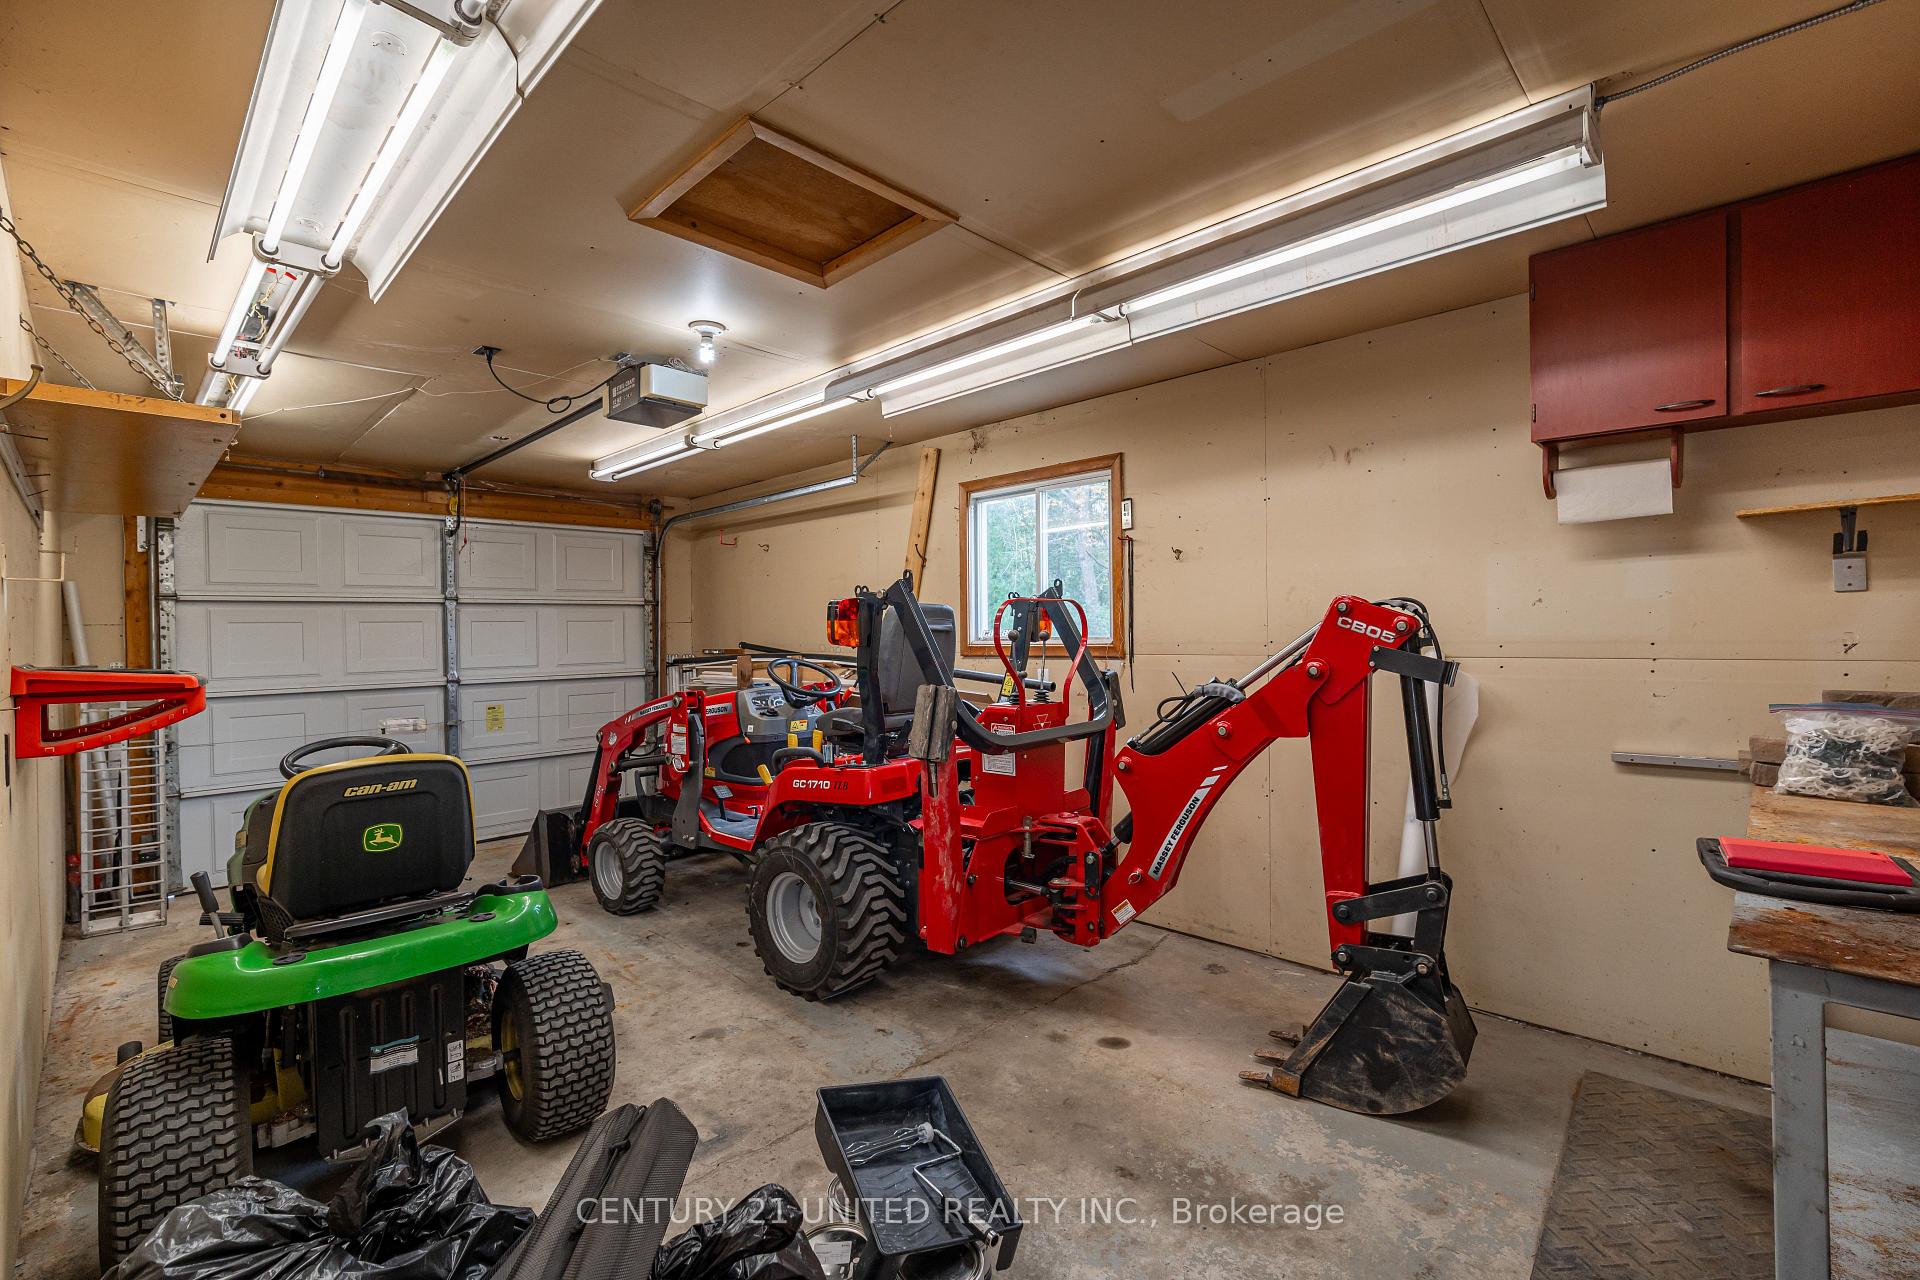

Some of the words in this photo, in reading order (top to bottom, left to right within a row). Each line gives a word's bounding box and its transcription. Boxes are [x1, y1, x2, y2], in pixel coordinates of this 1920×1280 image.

[705, 705, 729, 715] ERGUSON
[344, 779, 418, 798] can-am
[1152, 839, 1175, 876] MASSEY
[1170, 796, 1201, 841] FERGUSON
